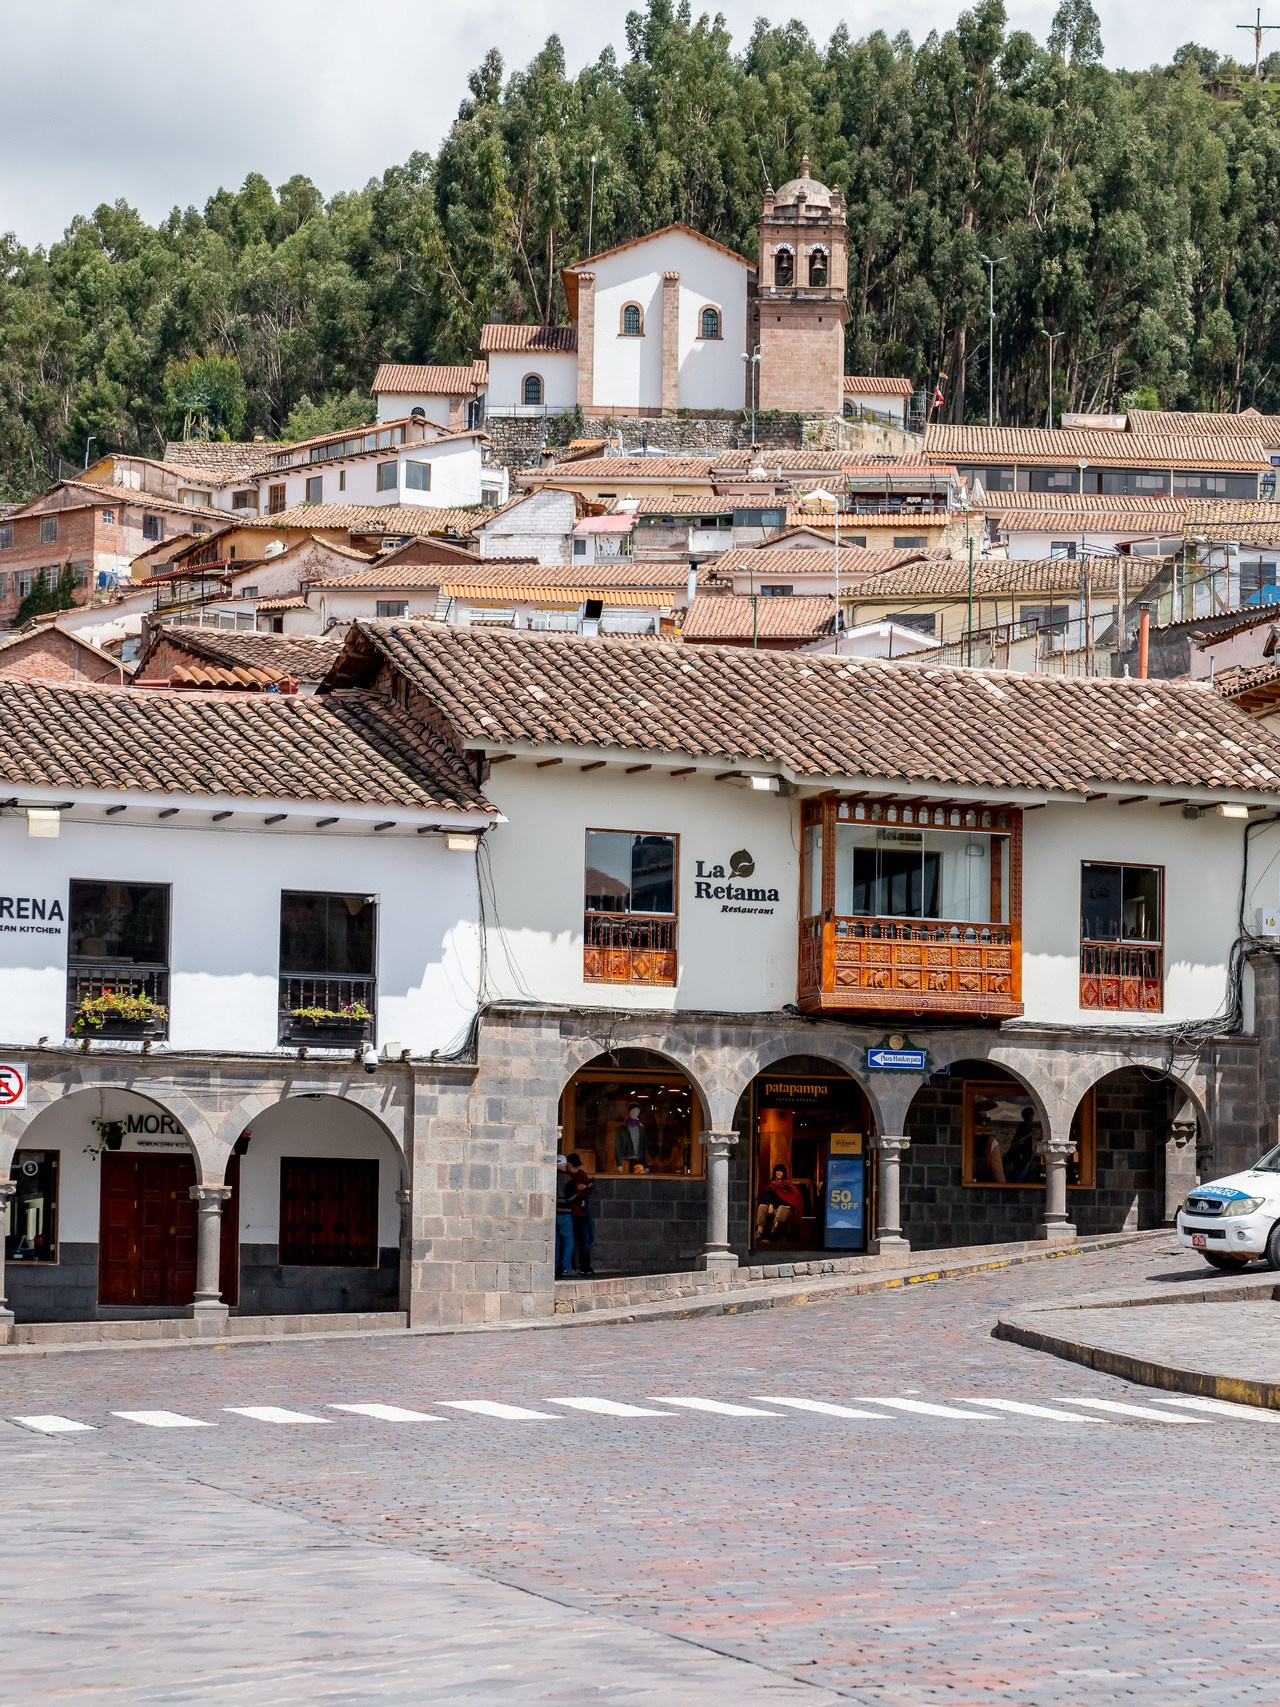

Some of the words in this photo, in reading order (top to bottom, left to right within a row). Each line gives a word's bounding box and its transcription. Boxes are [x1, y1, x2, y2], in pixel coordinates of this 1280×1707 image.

[695, 860, 726, 879] La
[694, 881, 780, 902] Retama
[0, 896, 65, 921] RENA
[720, 904, 774, 915] Restaurant
[19, 926, 62, 934] KITCHEN
[880, 1054, 893, 1062] Plaza
[765, 1082, 828, 1098] patapampa
[831, 1189, 852, 1203] 50
